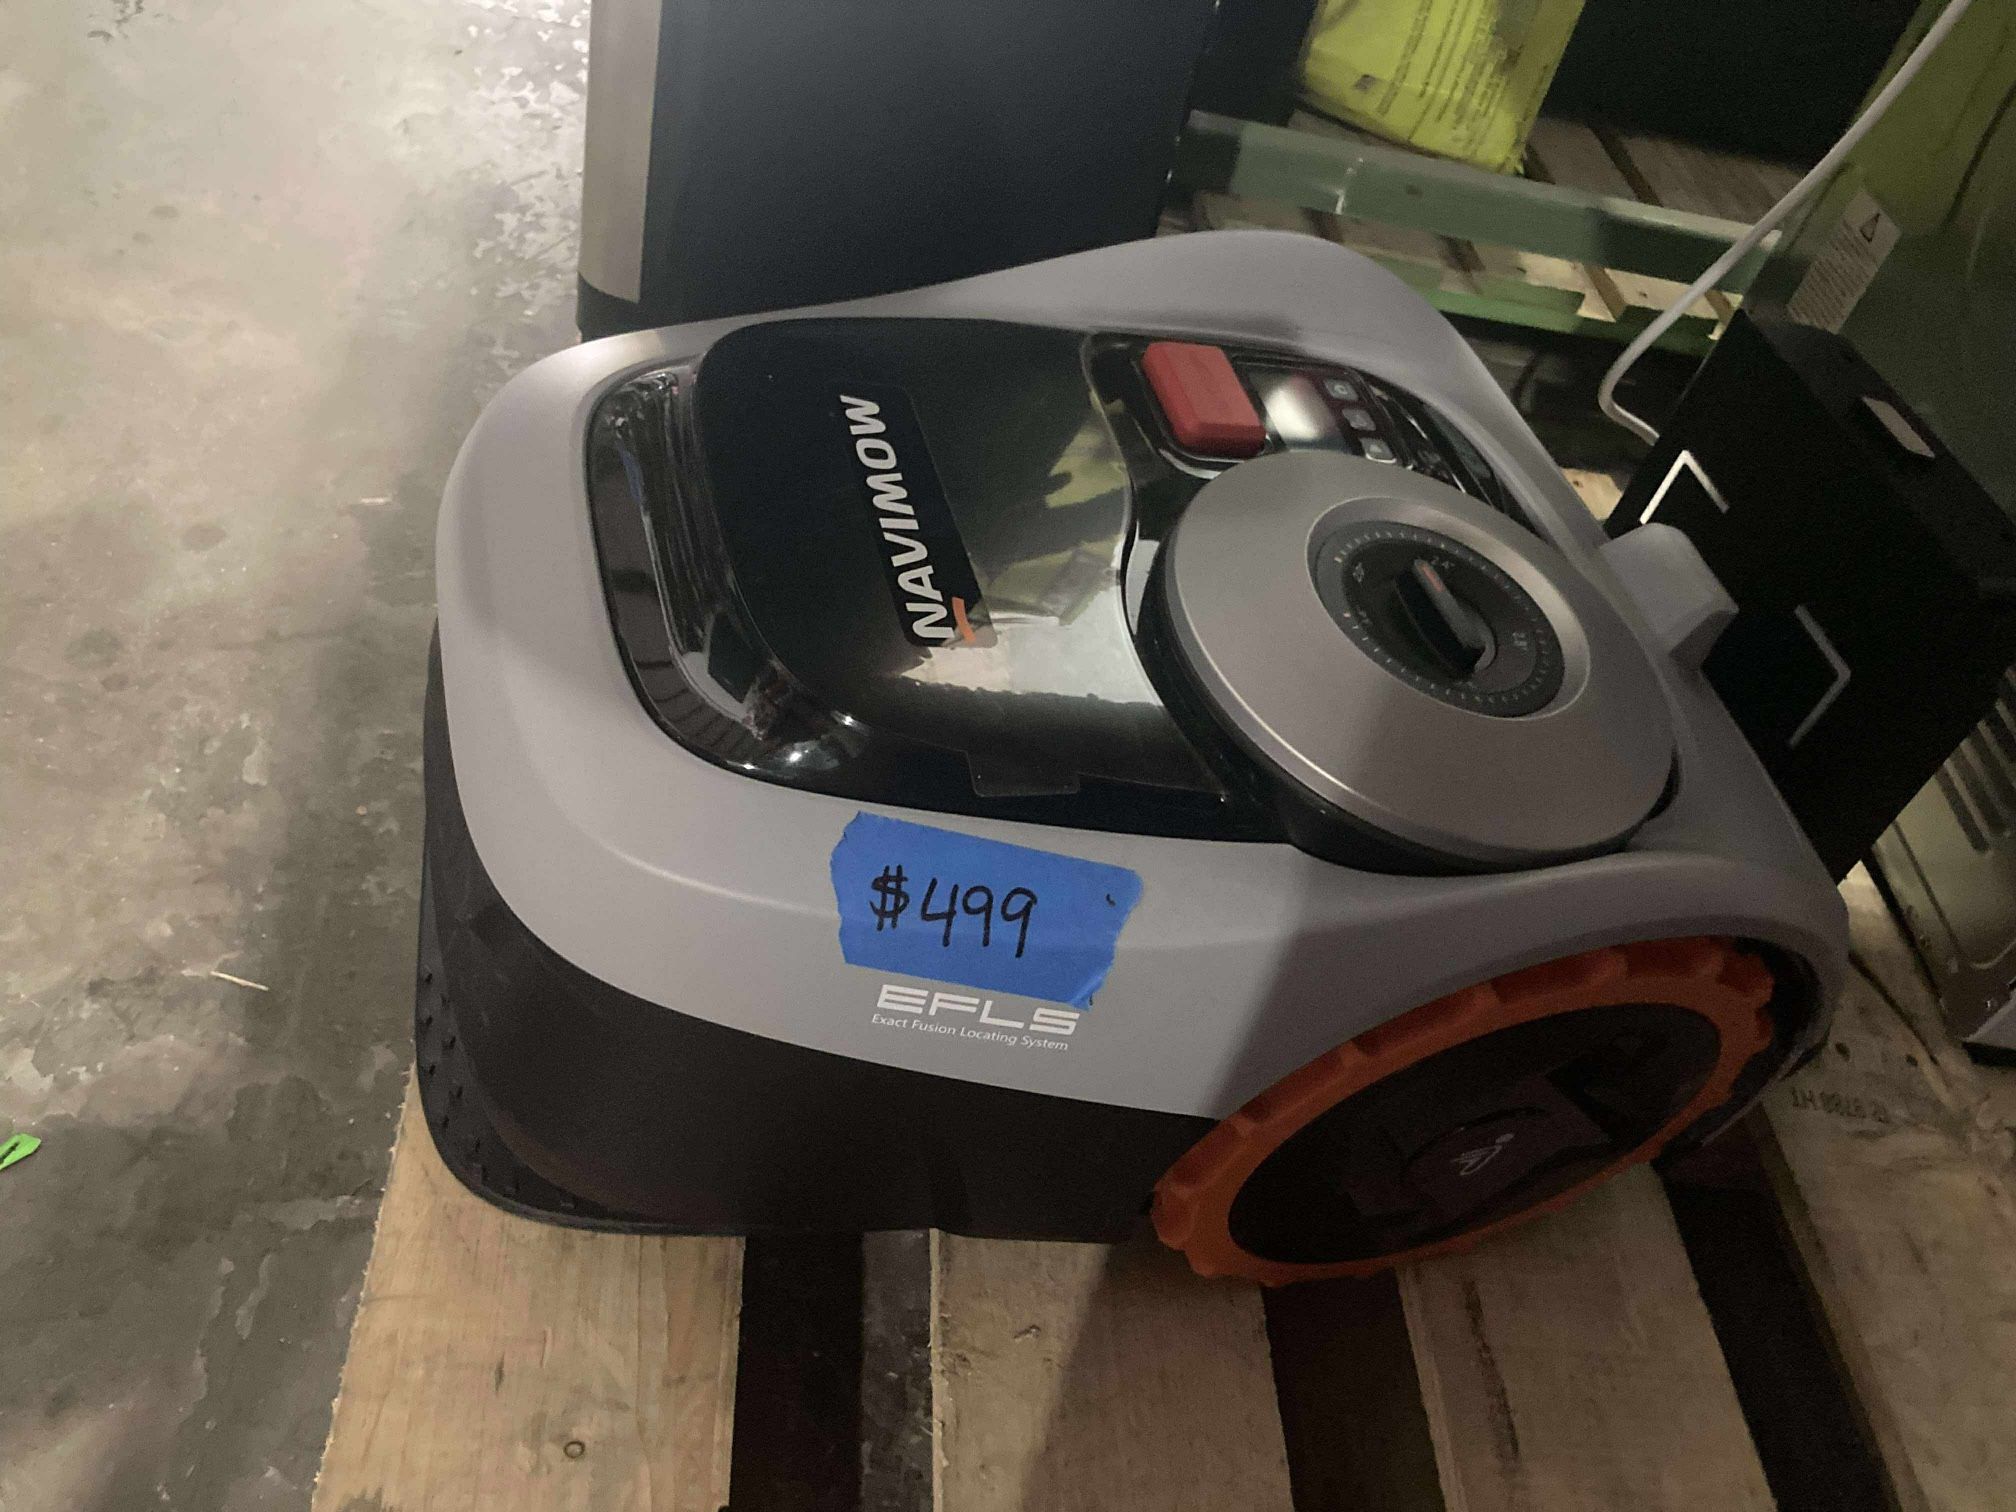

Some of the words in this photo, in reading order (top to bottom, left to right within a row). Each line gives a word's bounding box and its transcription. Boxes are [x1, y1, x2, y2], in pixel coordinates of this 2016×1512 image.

[839, 394, 956, 639] NAVIMOW
[869, 864, 1038, 959] $499
[871, 1013, 908, 1029] Exact
[911, 1019, 956, 1036] Fusion
[959, 1026, 1018, 1046] Locating
[1020, 1035, 1069, 1051] System
[876, 984, 1080, 1036] EFLS
